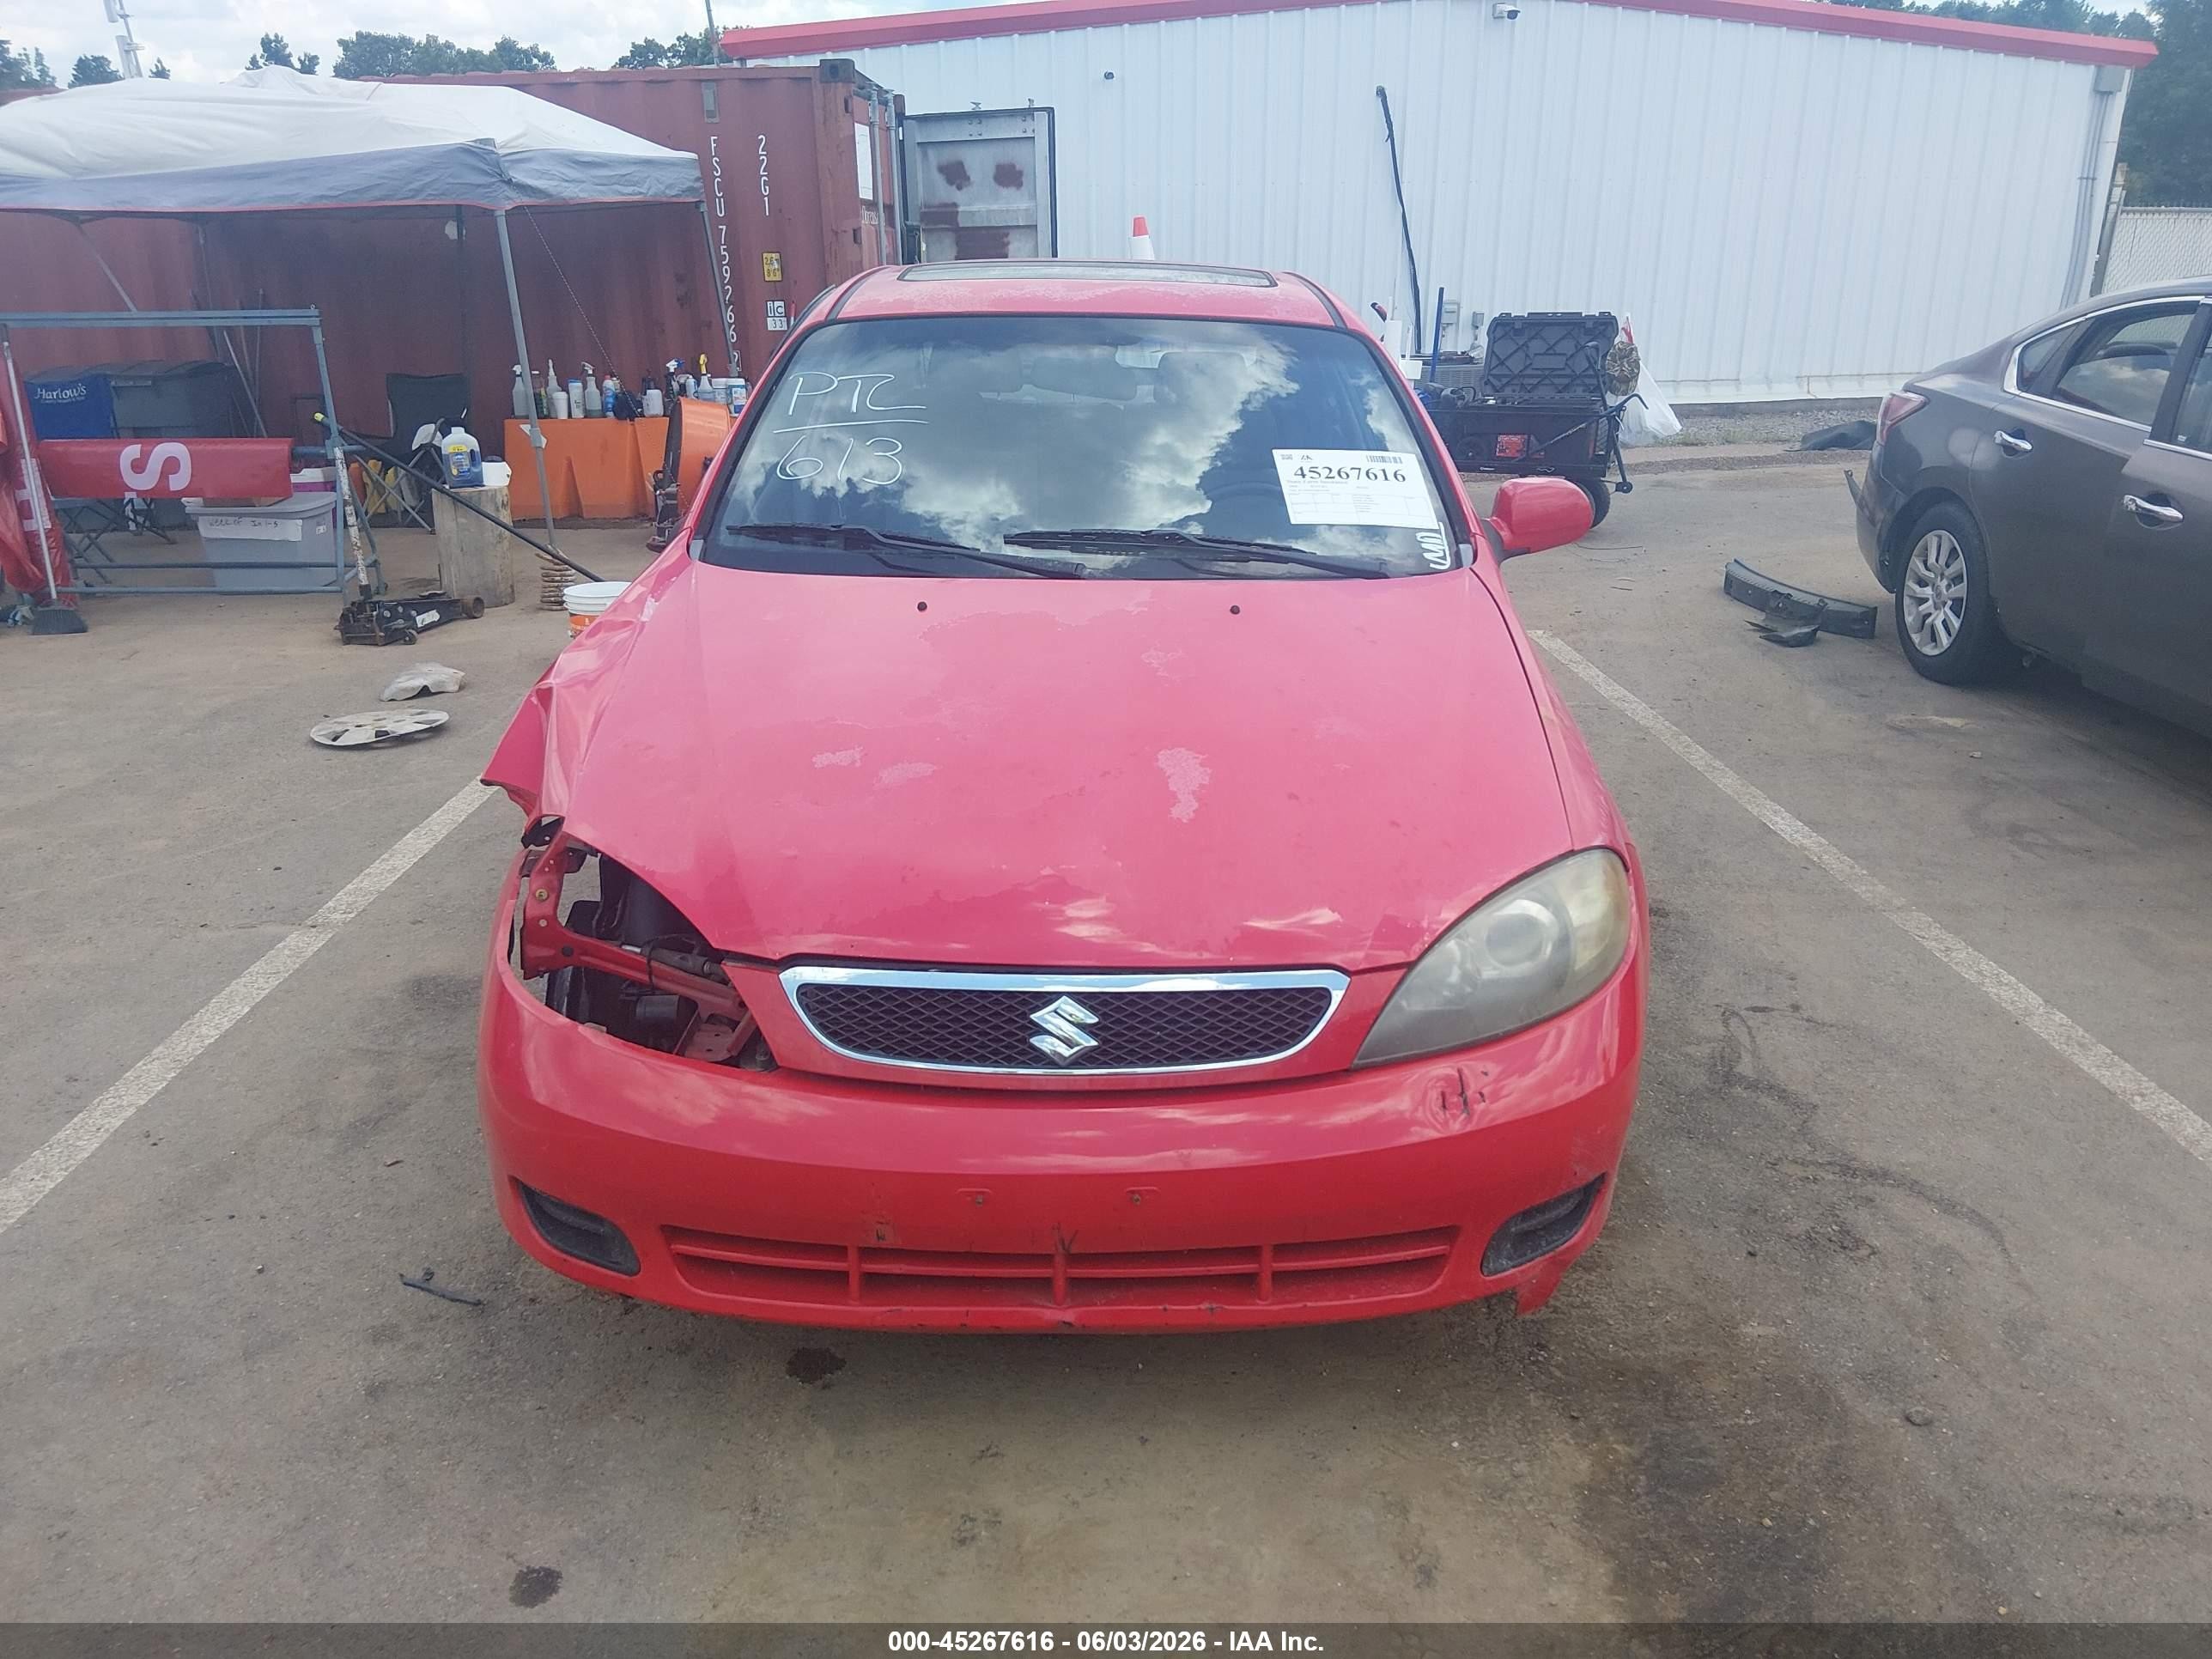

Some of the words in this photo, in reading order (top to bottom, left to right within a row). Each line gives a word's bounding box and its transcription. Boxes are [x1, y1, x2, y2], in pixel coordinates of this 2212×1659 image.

[710, 136, 726, 217] FSCU
[757, 135, 769, 216] 22G1
[772, 319, 783, 329] 33
[34, 383, 87, 399] Harlow's
[776, 434, 902, 485] 613
[1294, 465, 1407, 483] 45267616
